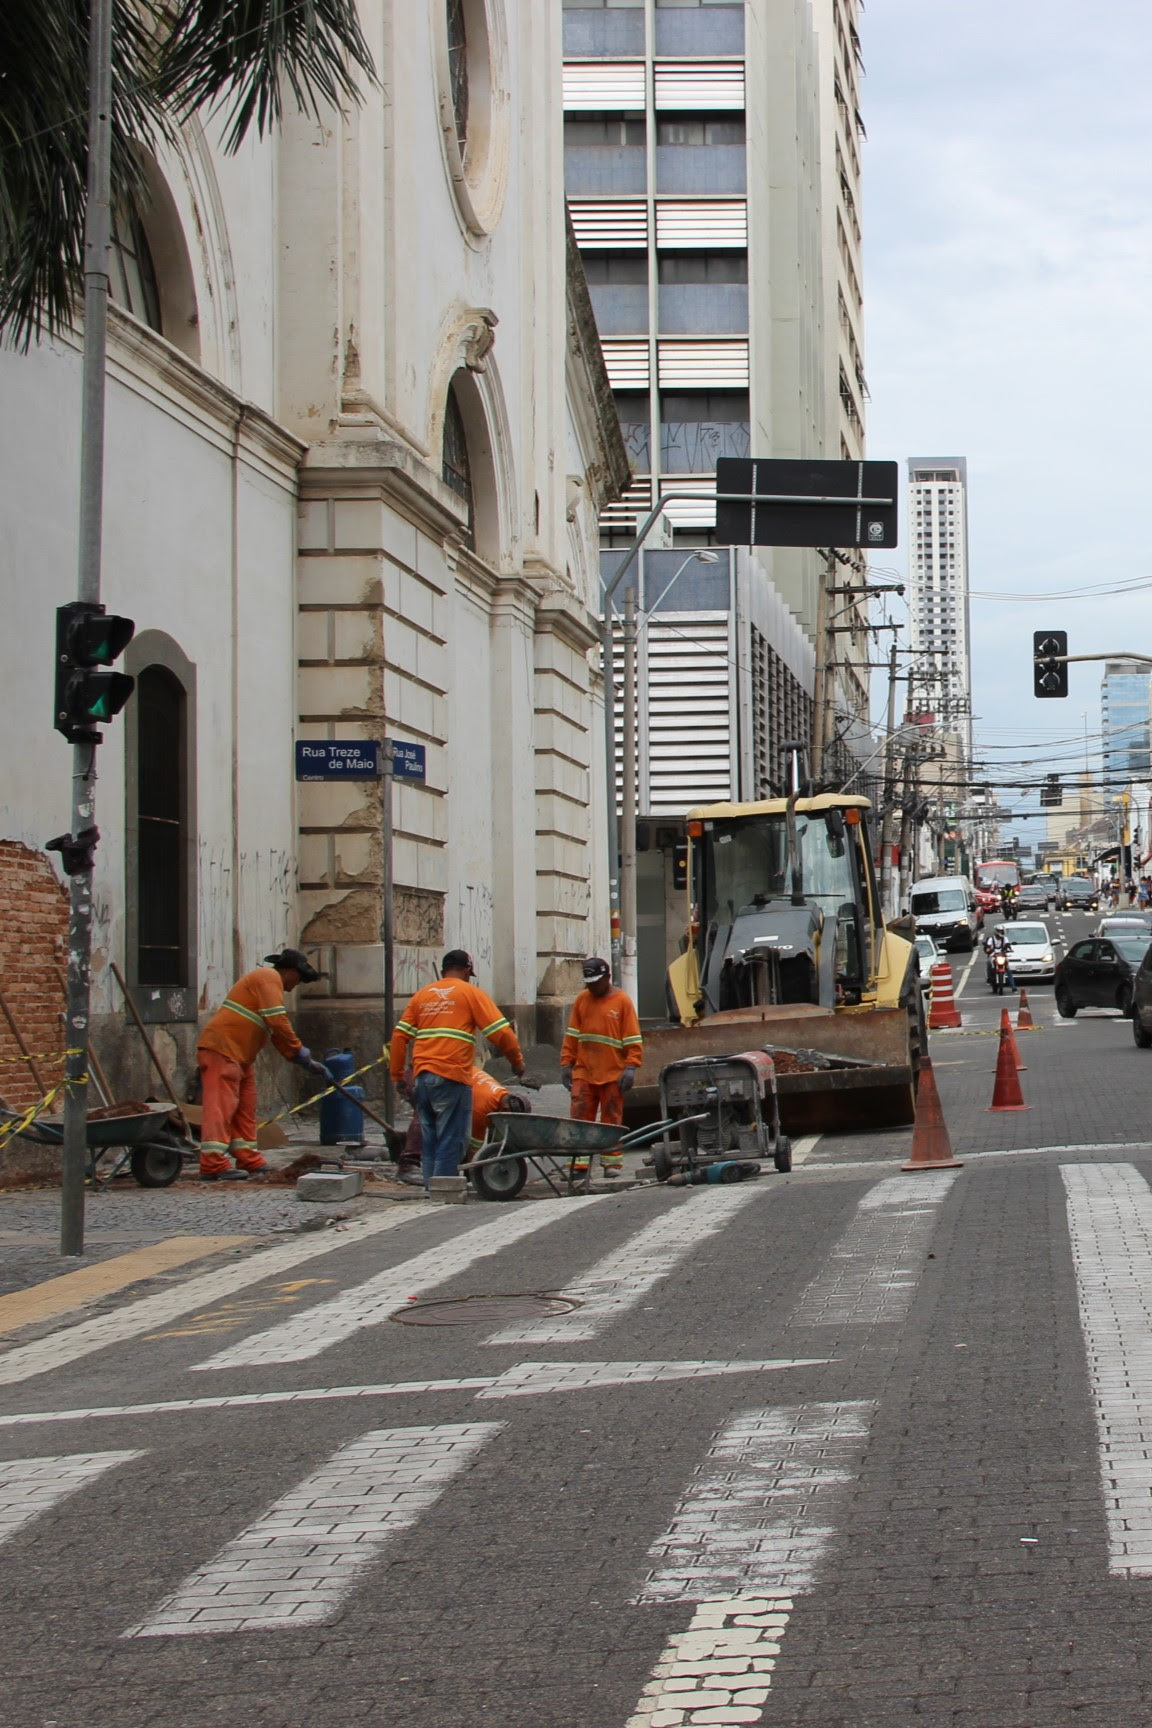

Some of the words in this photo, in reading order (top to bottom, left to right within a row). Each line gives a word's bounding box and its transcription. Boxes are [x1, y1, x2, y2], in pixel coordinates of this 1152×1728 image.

[302, 747, 325, 758] Rua
[328, 746, 361, 758] Treze
[328, 759, 343, 769] de
[346, 759, 374, 769] Maio
